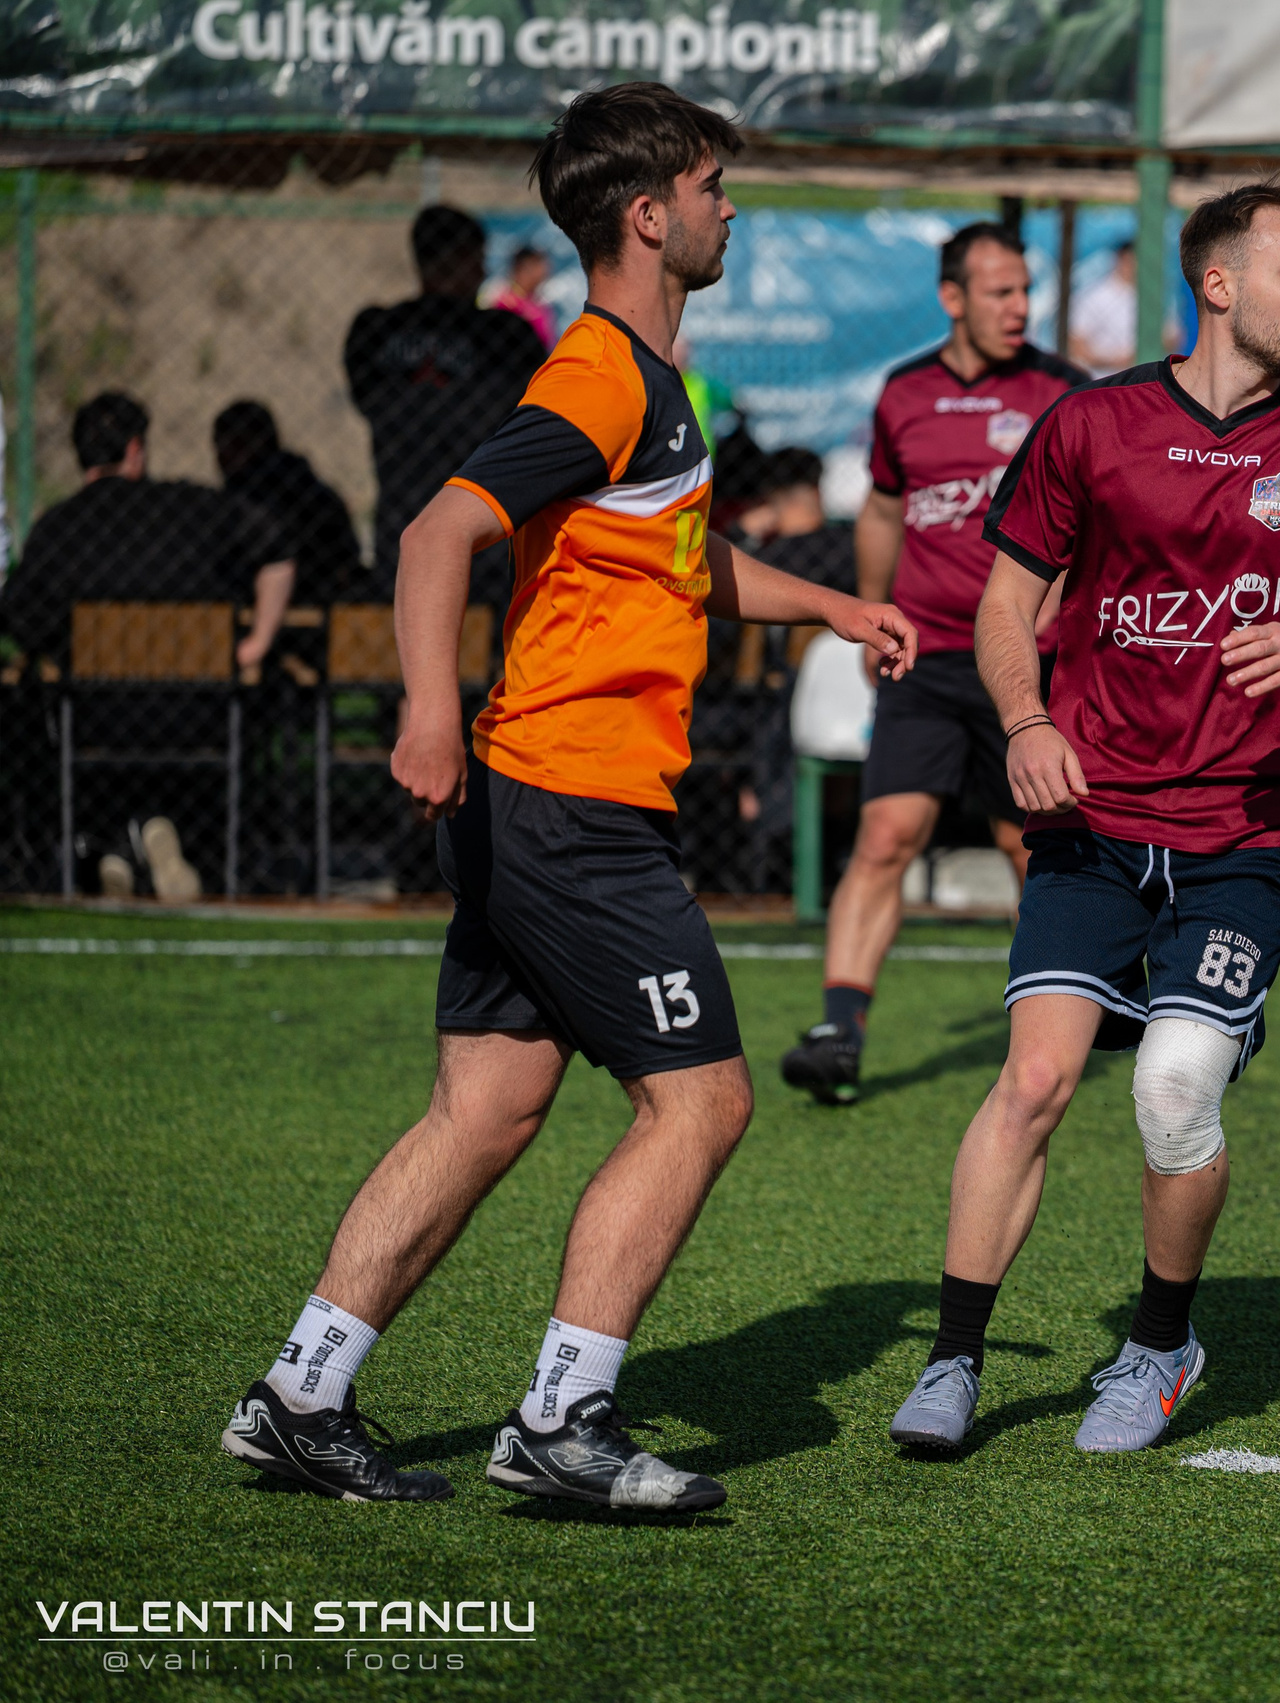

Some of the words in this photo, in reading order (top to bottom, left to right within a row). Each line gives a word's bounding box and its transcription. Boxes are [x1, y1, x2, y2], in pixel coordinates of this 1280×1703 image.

[192, 0, 505, 66] Cultivăm
[514, 8, 881, 82] campionii!
[1168, 447, 1262, 467] GIVOVA
[1196, 942, 1256, 999] 83
[1207, 928, 1234, 943] SAN
[1233, 932, 1262, 962] DIEGO
[638, 969, 701, 1033] 13
